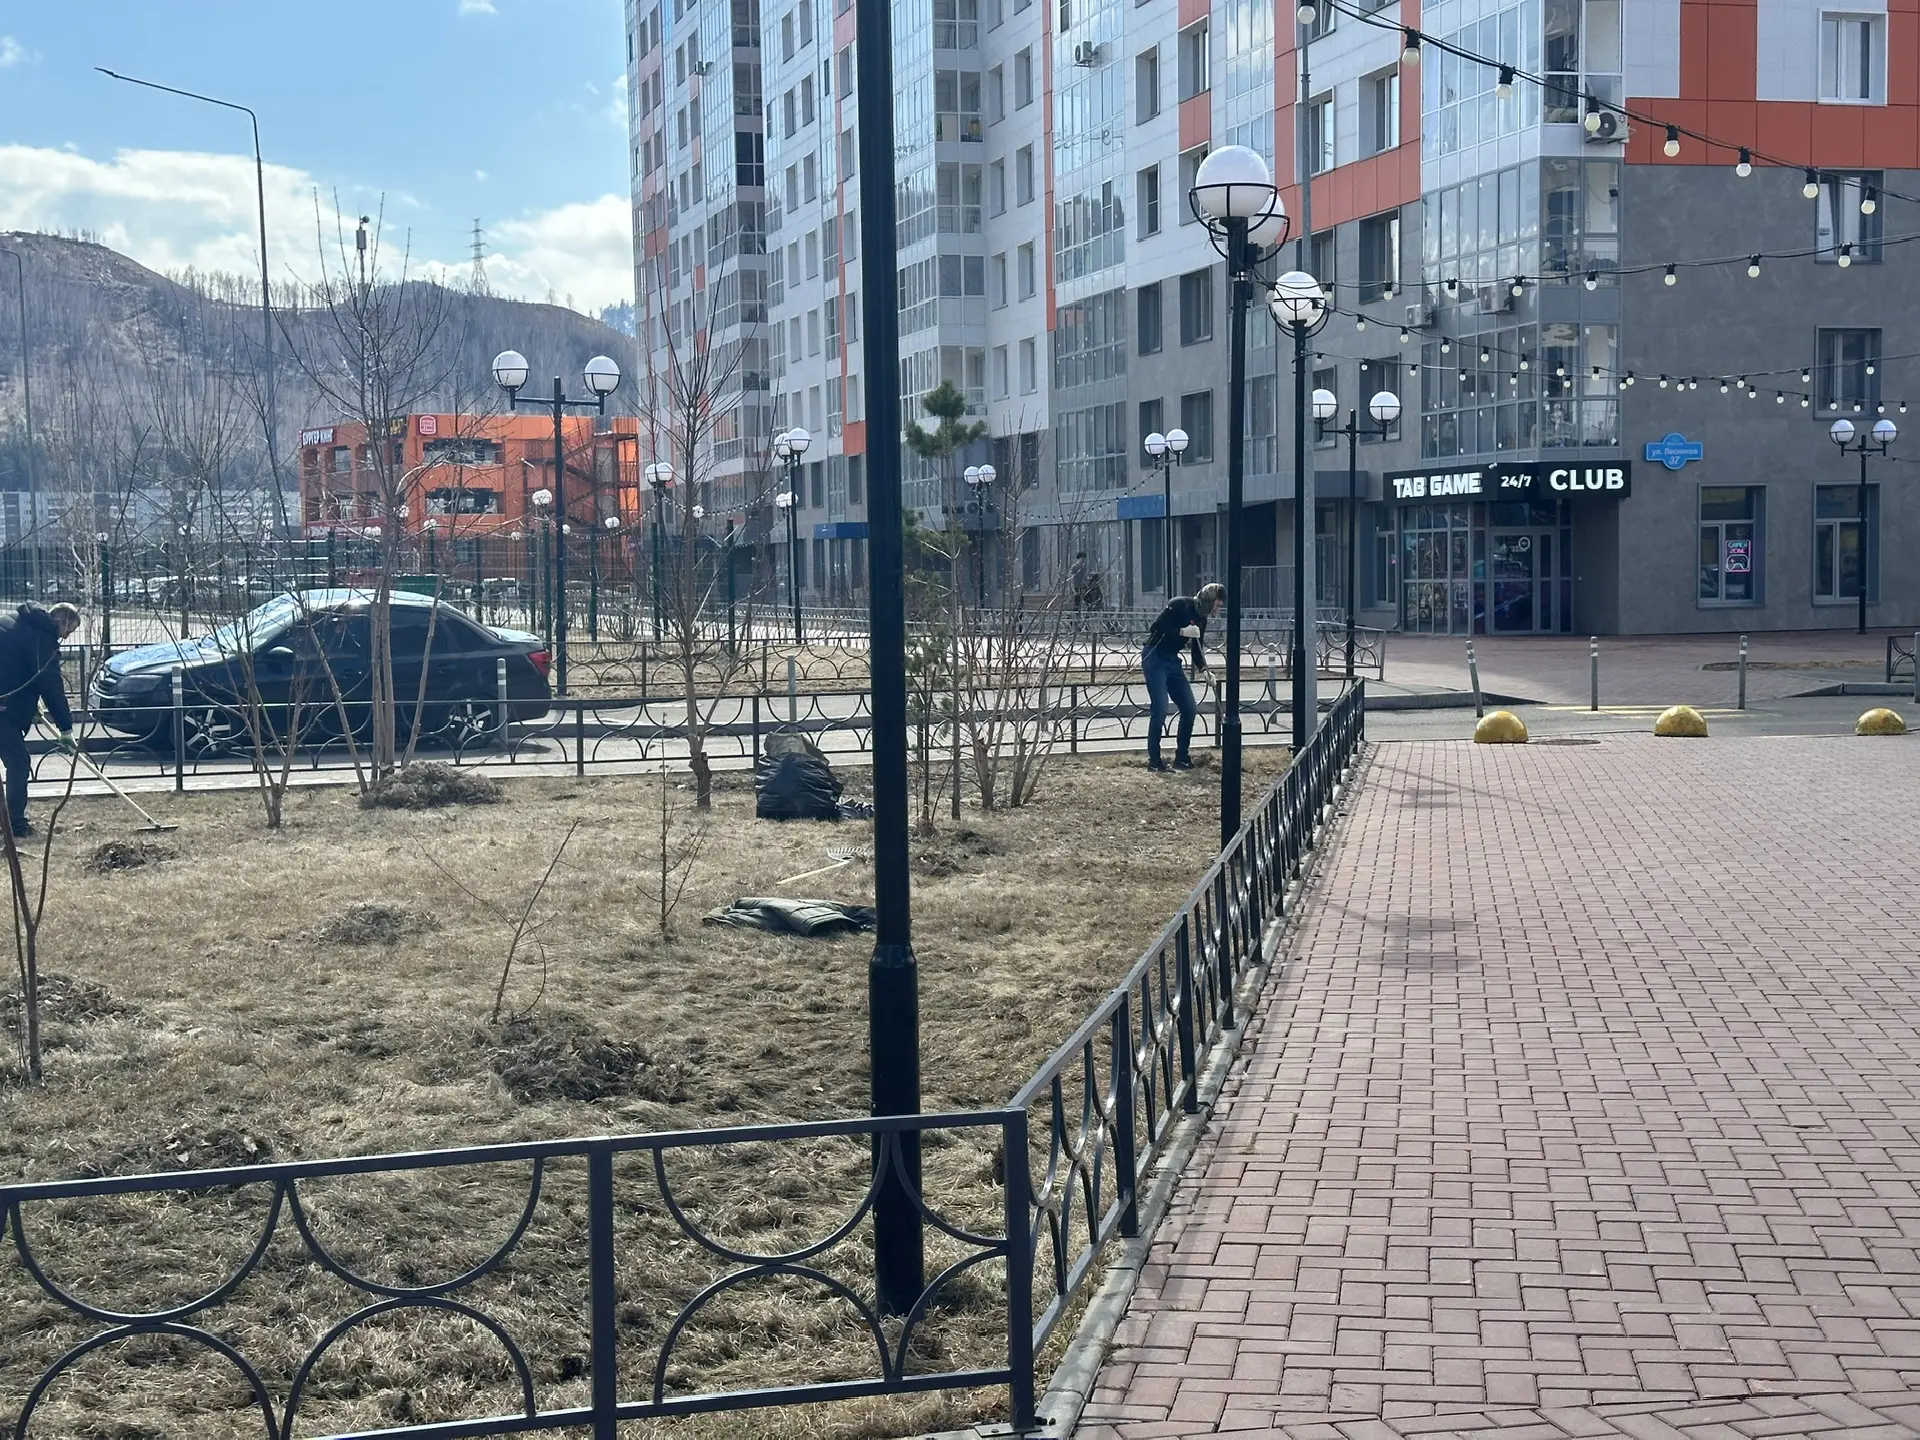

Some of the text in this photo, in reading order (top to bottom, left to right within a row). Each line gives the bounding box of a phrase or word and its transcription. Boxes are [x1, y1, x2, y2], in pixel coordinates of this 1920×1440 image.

[1669, 455, 1680, 465] 37
[1393, 469, 1624, 499] TAB GAME 24/7 CLUB
